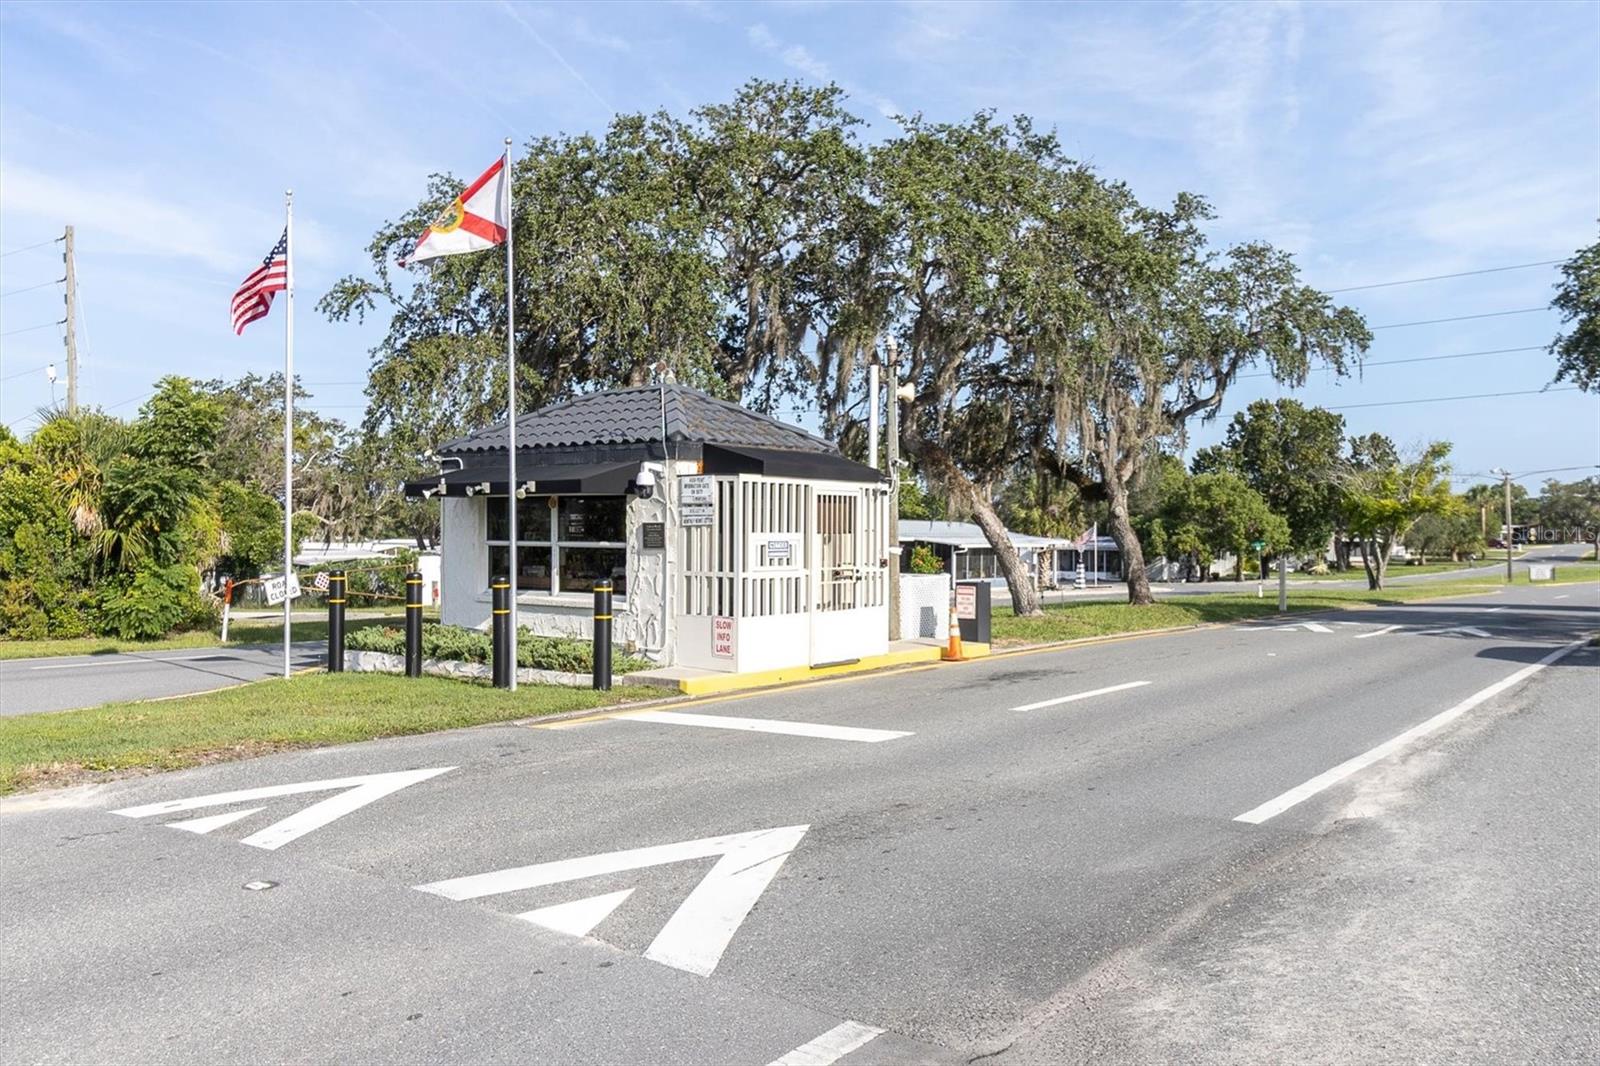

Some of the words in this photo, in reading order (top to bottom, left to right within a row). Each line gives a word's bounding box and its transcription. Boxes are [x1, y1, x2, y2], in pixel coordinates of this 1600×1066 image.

[272, 580, 287, 590] ROA
[270, 586, 297, 601] CLOD
[715, 621, 732, 630] SLOW
[716, 633, 731, 641] INFO
[715, 644, 731, 654] LANE
